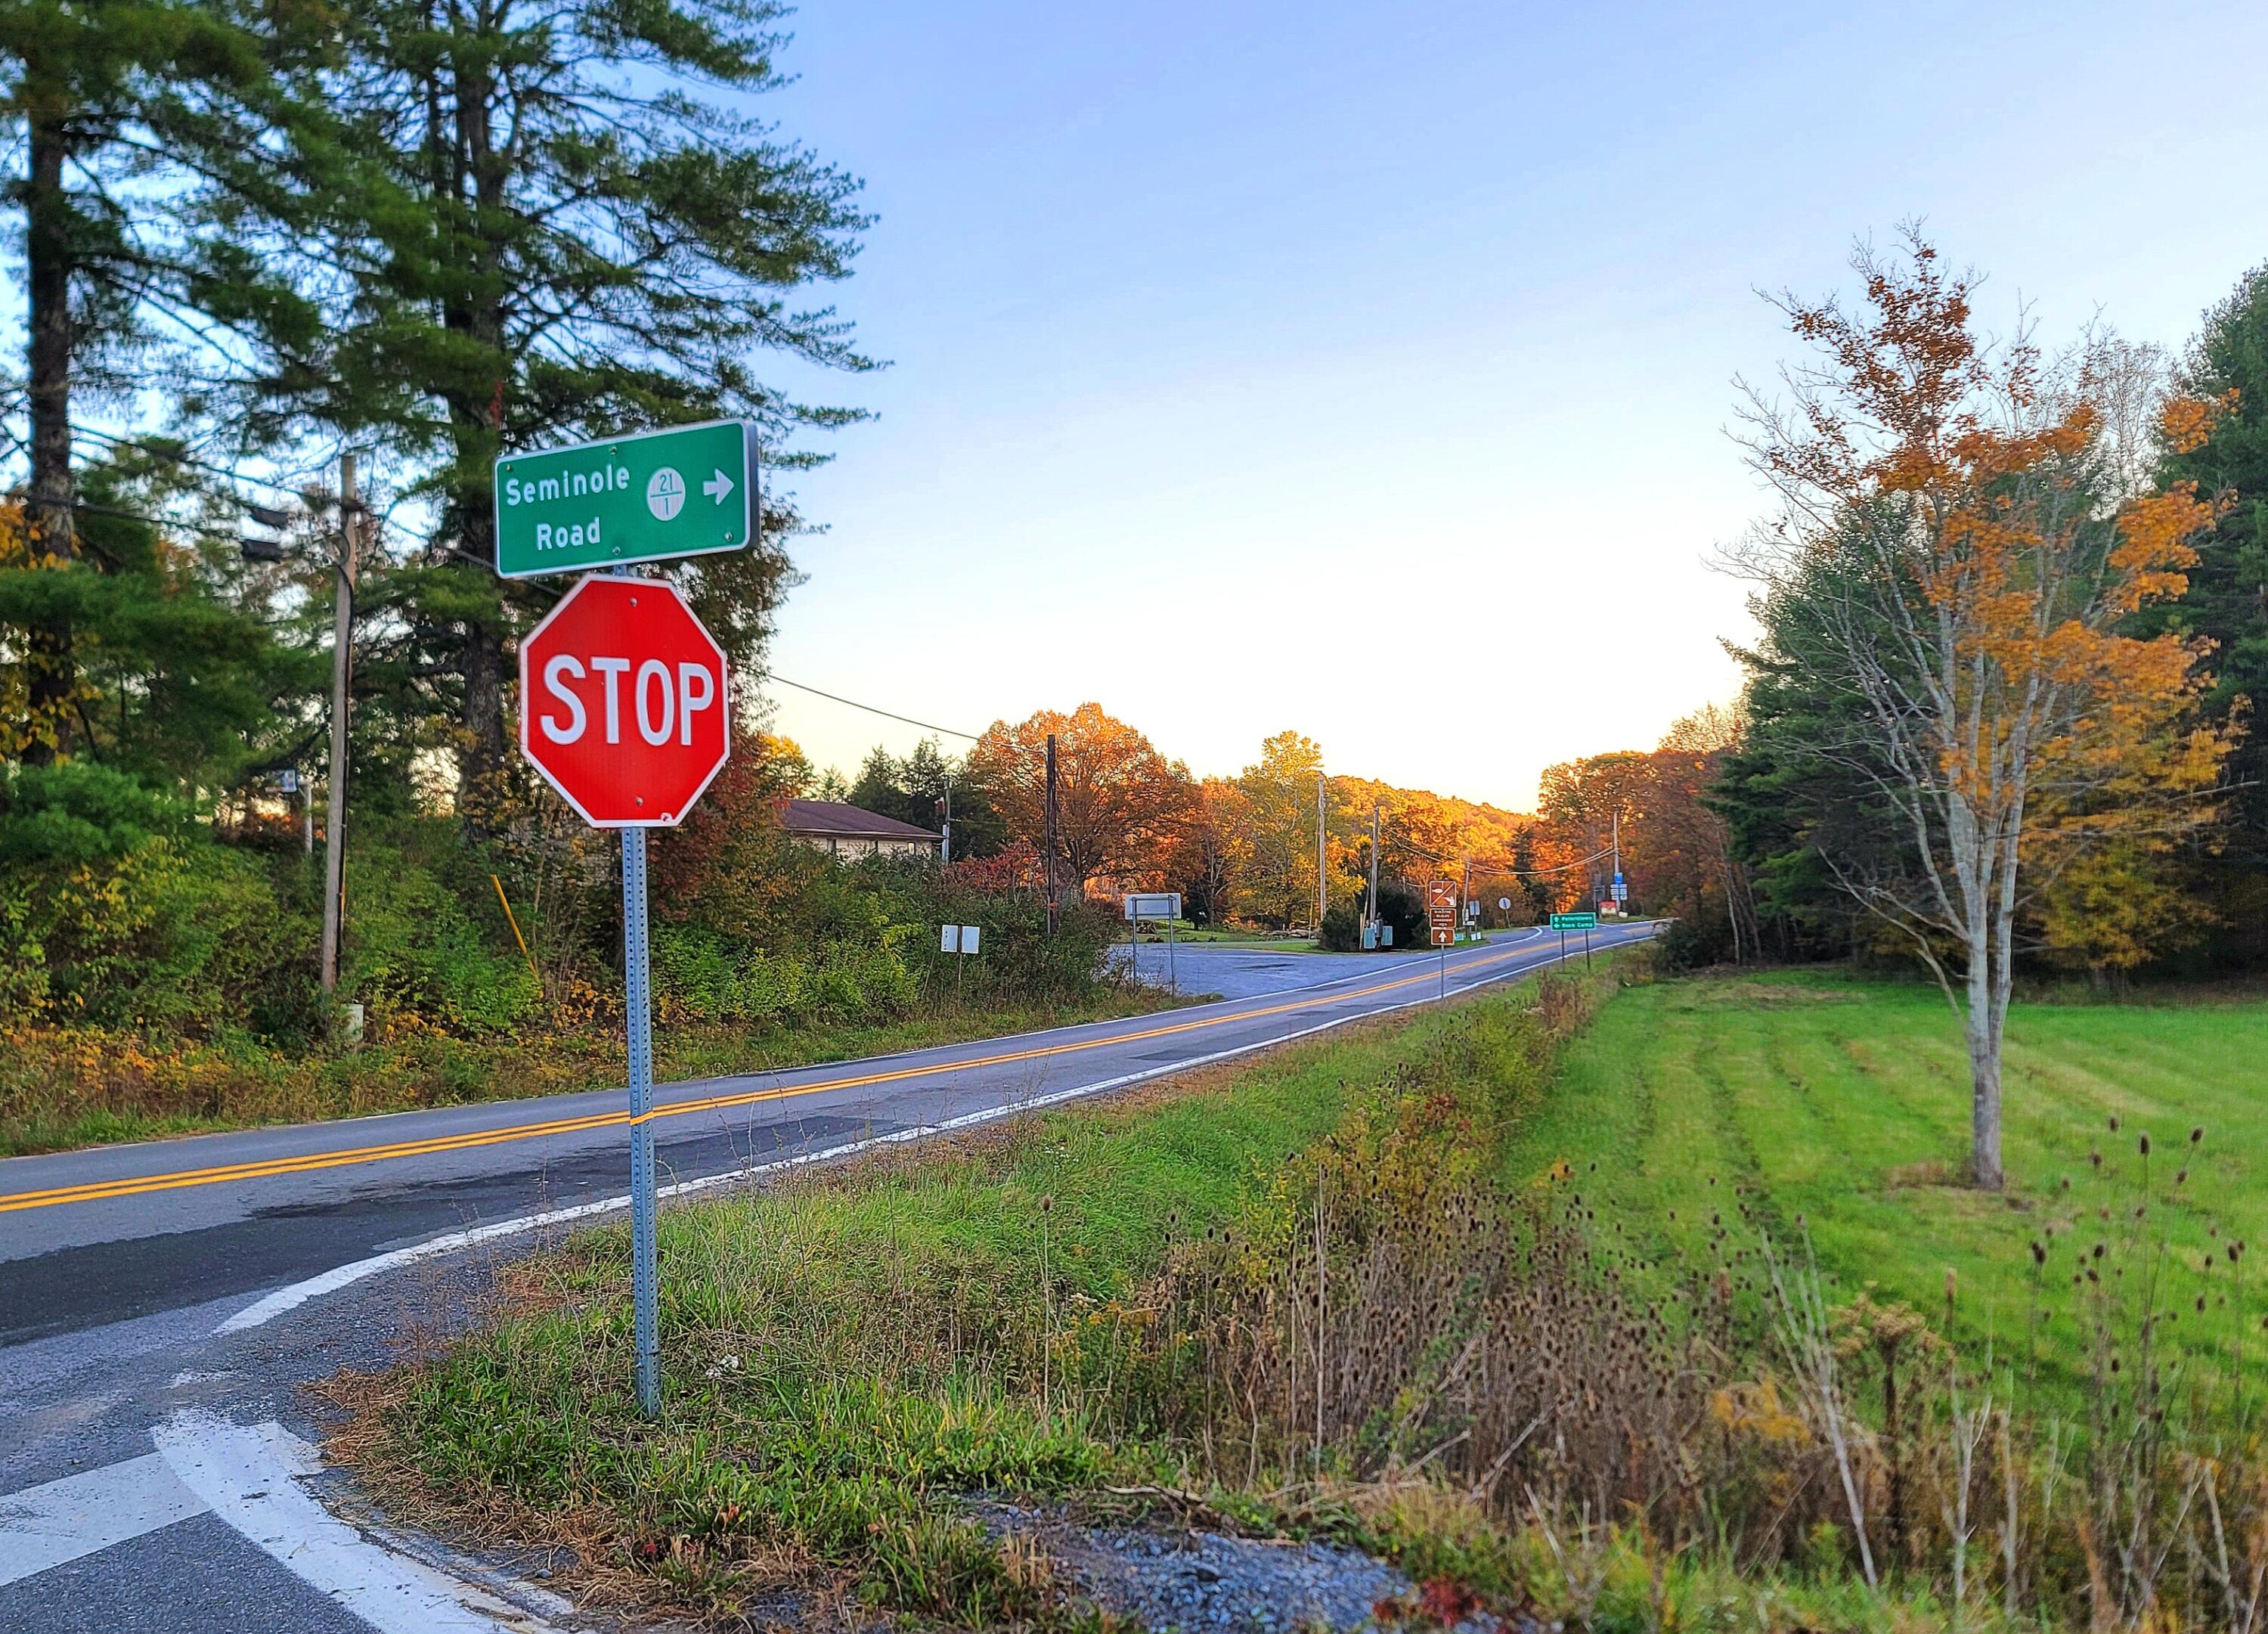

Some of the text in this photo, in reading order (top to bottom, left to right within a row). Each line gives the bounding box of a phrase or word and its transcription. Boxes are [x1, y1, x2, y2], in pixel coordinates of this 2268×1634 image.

[506, 463, 630, 506] Seminole
[659, 473, 673, 491] 21
[537, 516, 600, 551] Road
[540, 653, 714, 746] STOP
